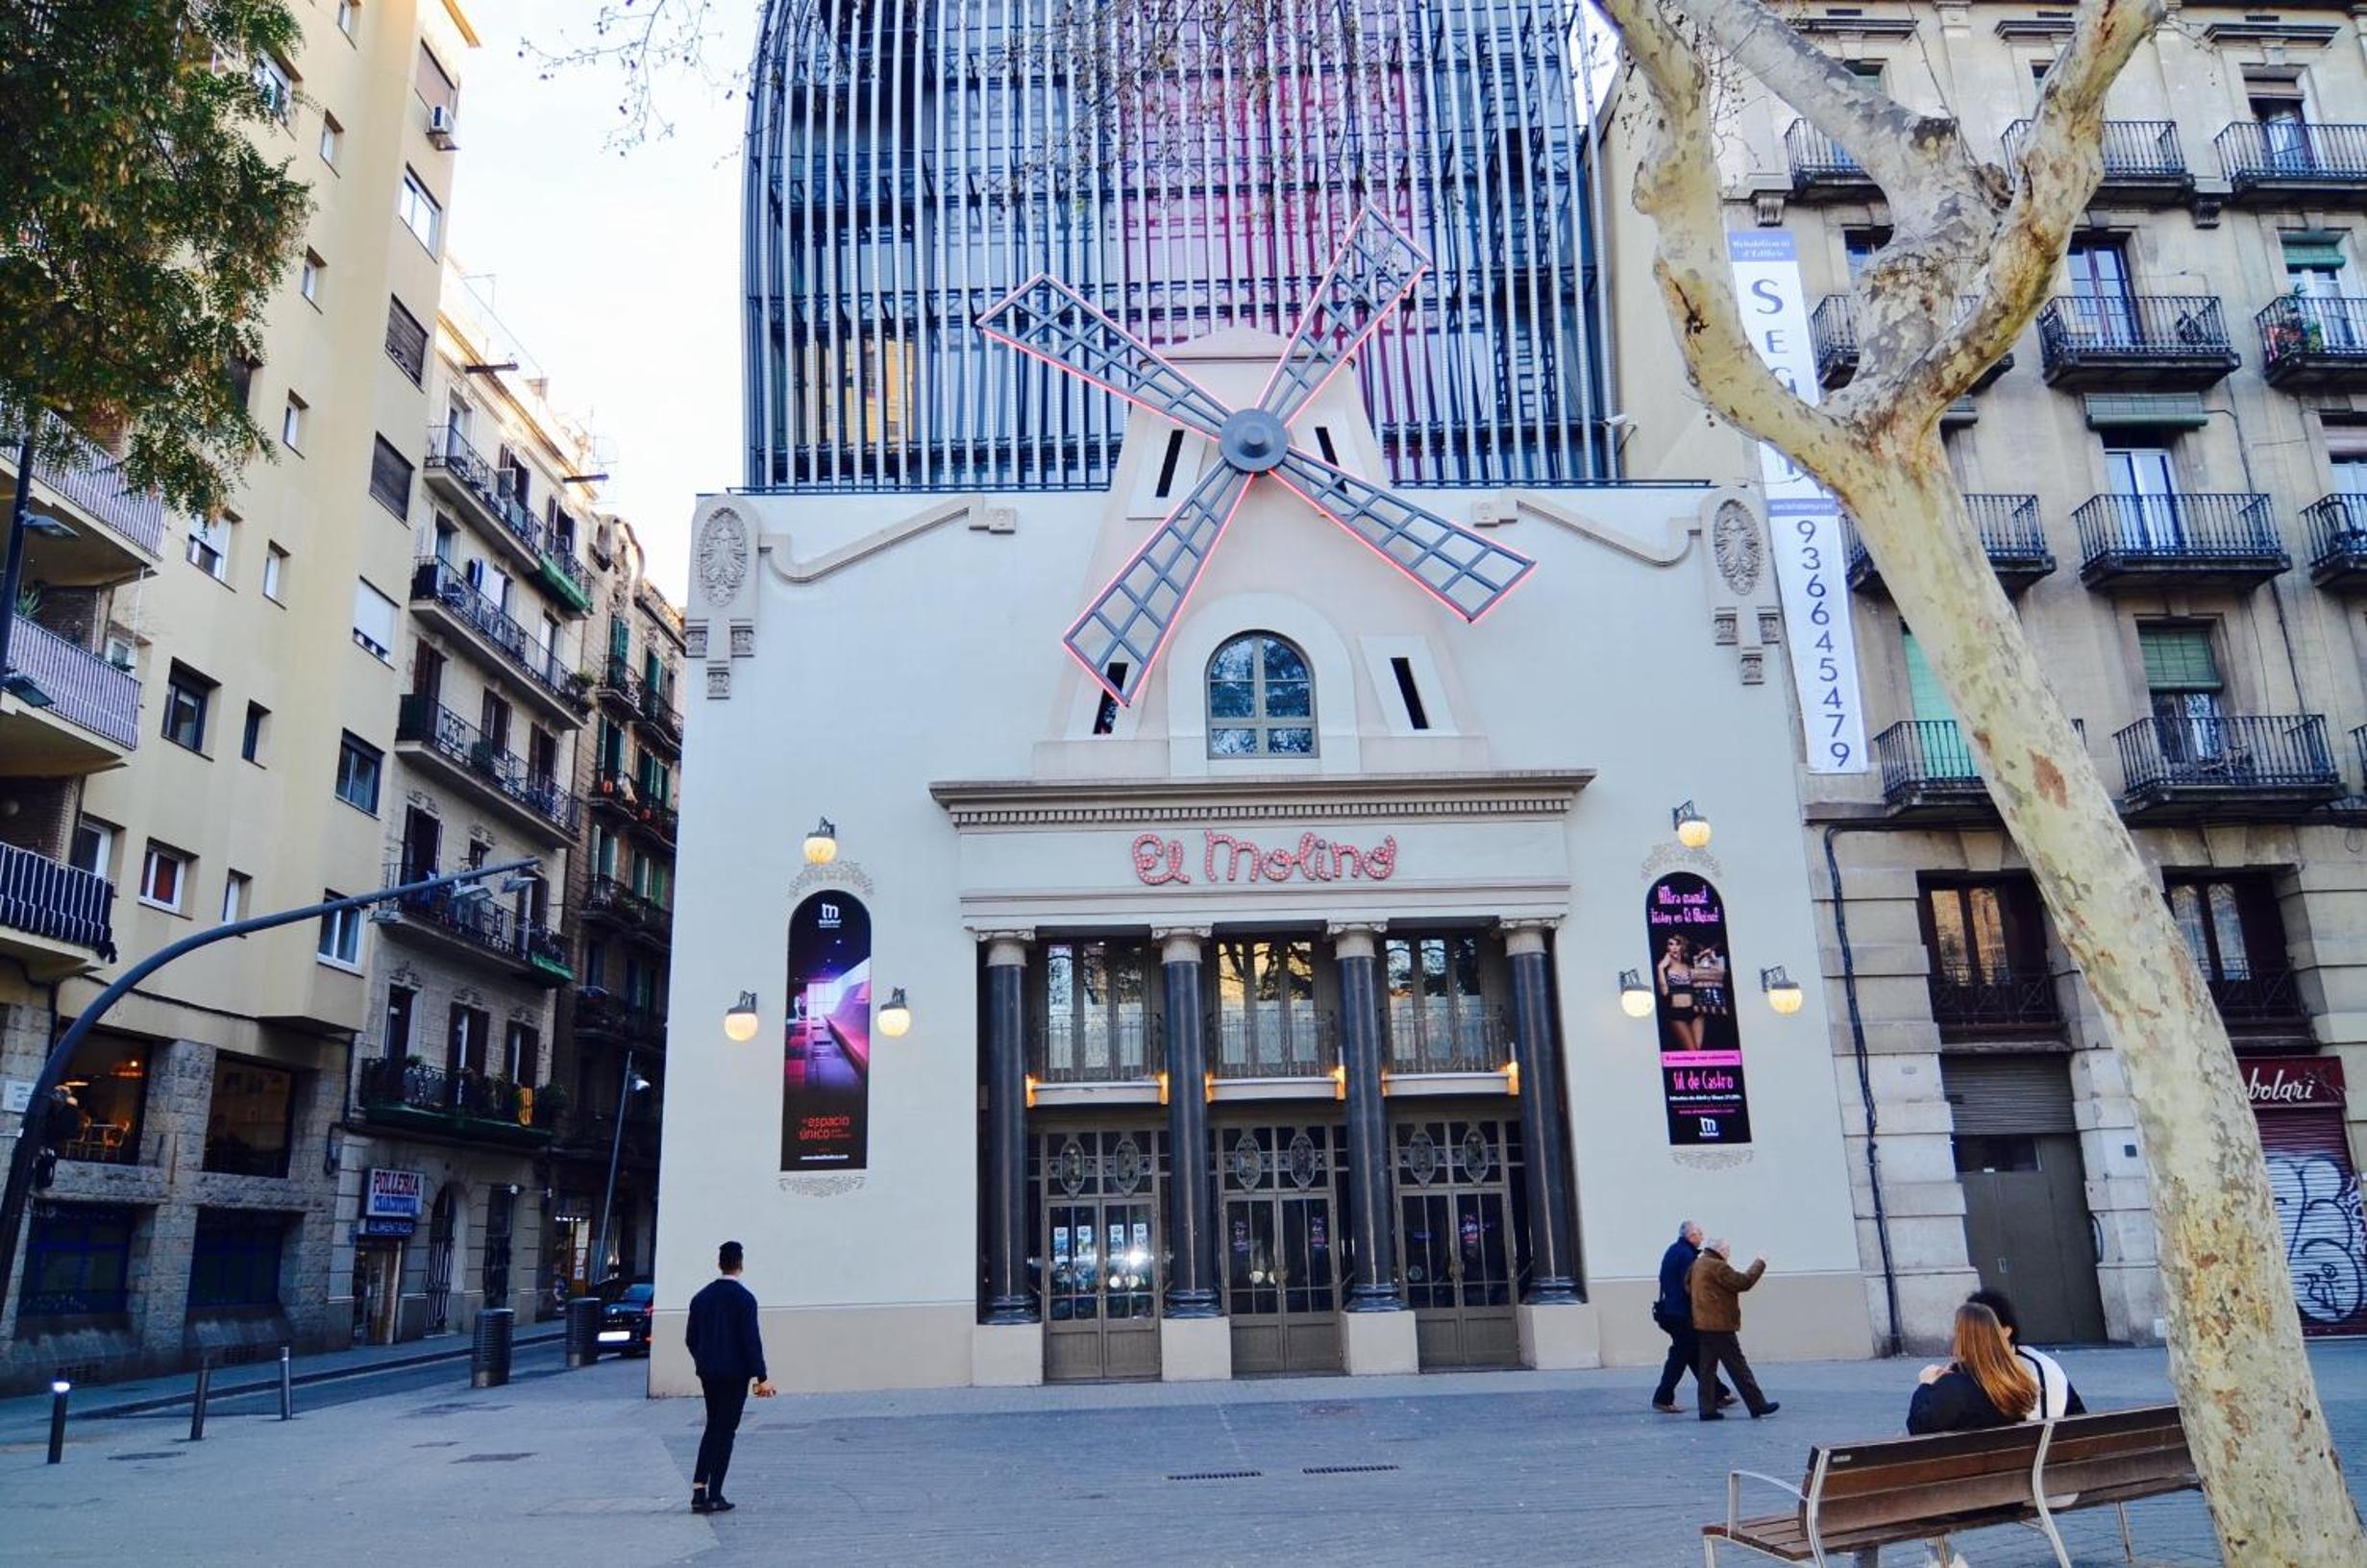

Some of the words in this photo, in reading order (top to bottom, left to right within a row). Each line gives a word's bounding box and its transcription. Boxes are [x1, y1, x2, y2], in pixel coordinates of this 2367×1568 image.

[1796, 520, 1850, 768] 936645479
[1132, 832, 1190, 885] El
[1688, 1070, 1700, 1090] de
[1702, 1069, 1735, 1090] Castro
[2244, 1067, 2316, 1102] bolari
[807, 1115, 850, 1129] espacio
